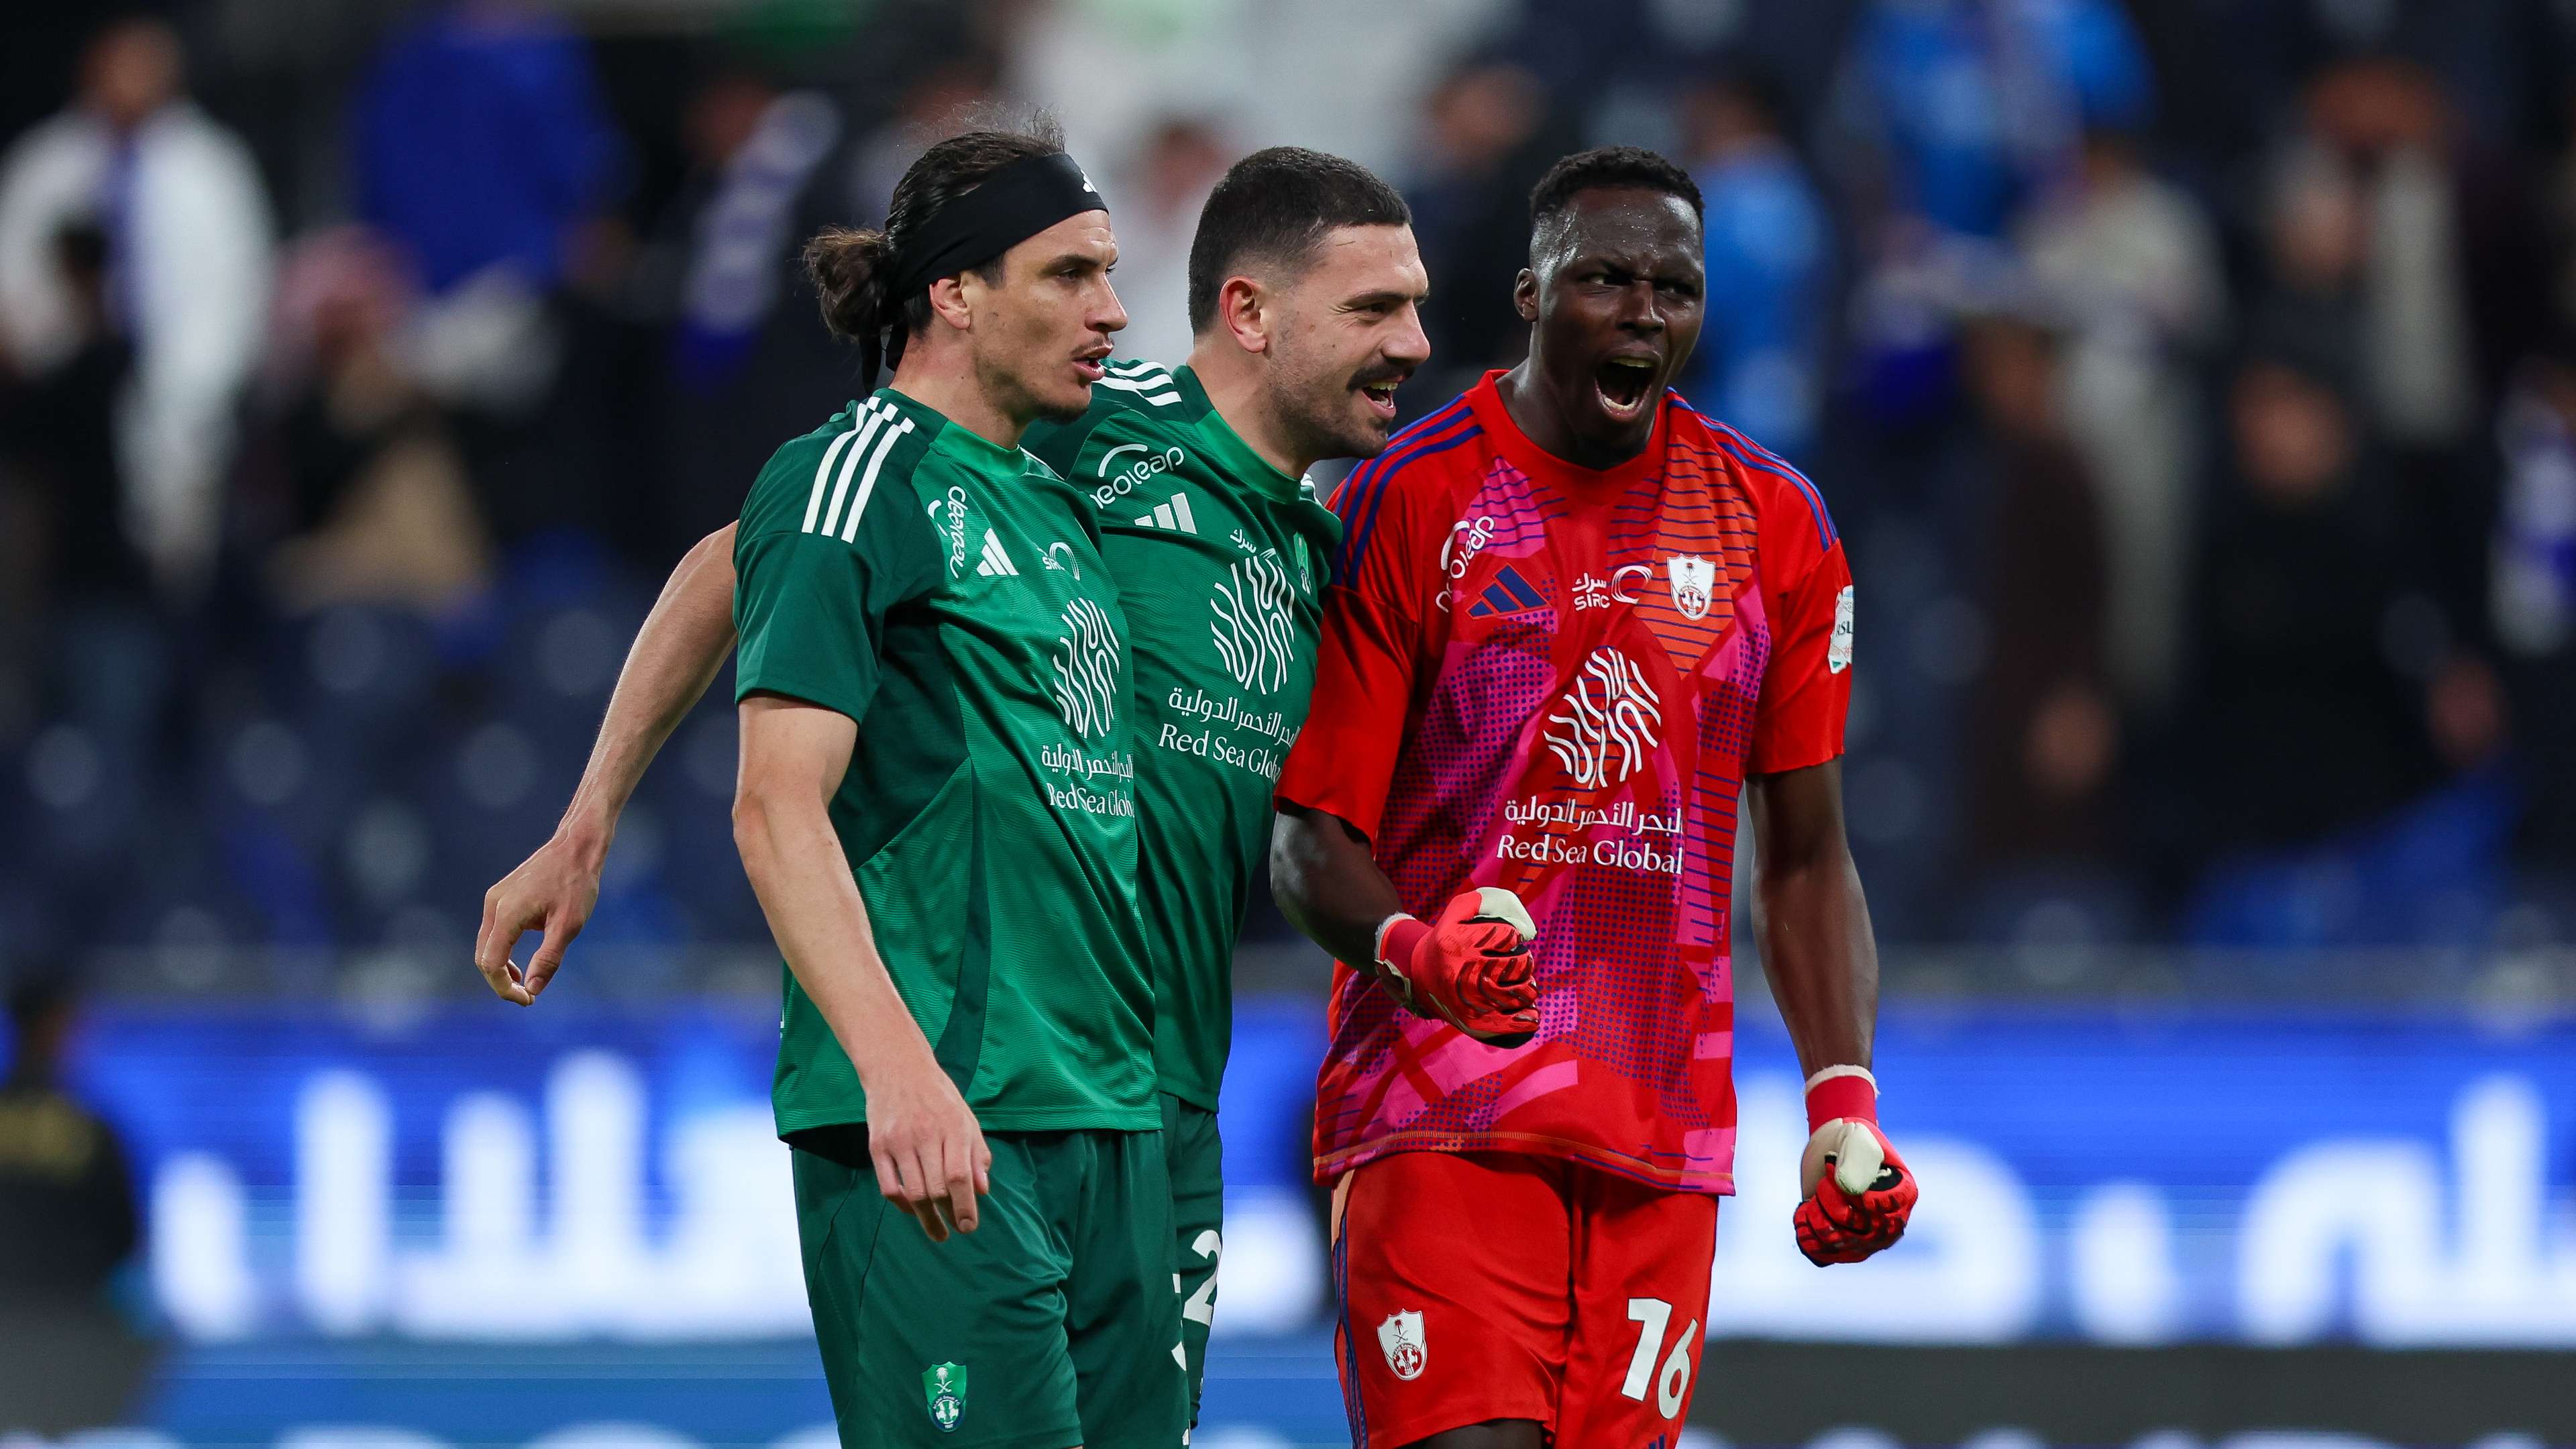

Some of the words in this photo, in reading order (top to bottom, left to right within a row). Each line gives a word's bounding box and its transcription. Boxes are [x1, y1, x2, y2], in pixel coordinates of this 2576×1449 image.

[1571, 572, 1607, 593] سرك
[1574, 593, 1611, 611] SIRC
[1169, 687, 1238, 722] الدولية
[1234, 711, 1282, 737] الأحمر
[1158, 723, 1210, 757] Red
[1213, 737, 1245, 767] Sea
[1046, 783, 1079, 810] Red
[1077, 788, 1106, 814] Sea
[1108, 790, 1134, 818] Glob
[1505, 795, 1575, 828] الدولية
[1572, 800, 1634, 832] الأحمر
[1496, 834, 1550, 861] Red
[1552, 839, 1588, 865] Sea
[1593, 840, 1683, 875] Global
[1621, 1297, 1698, 1420] 16
